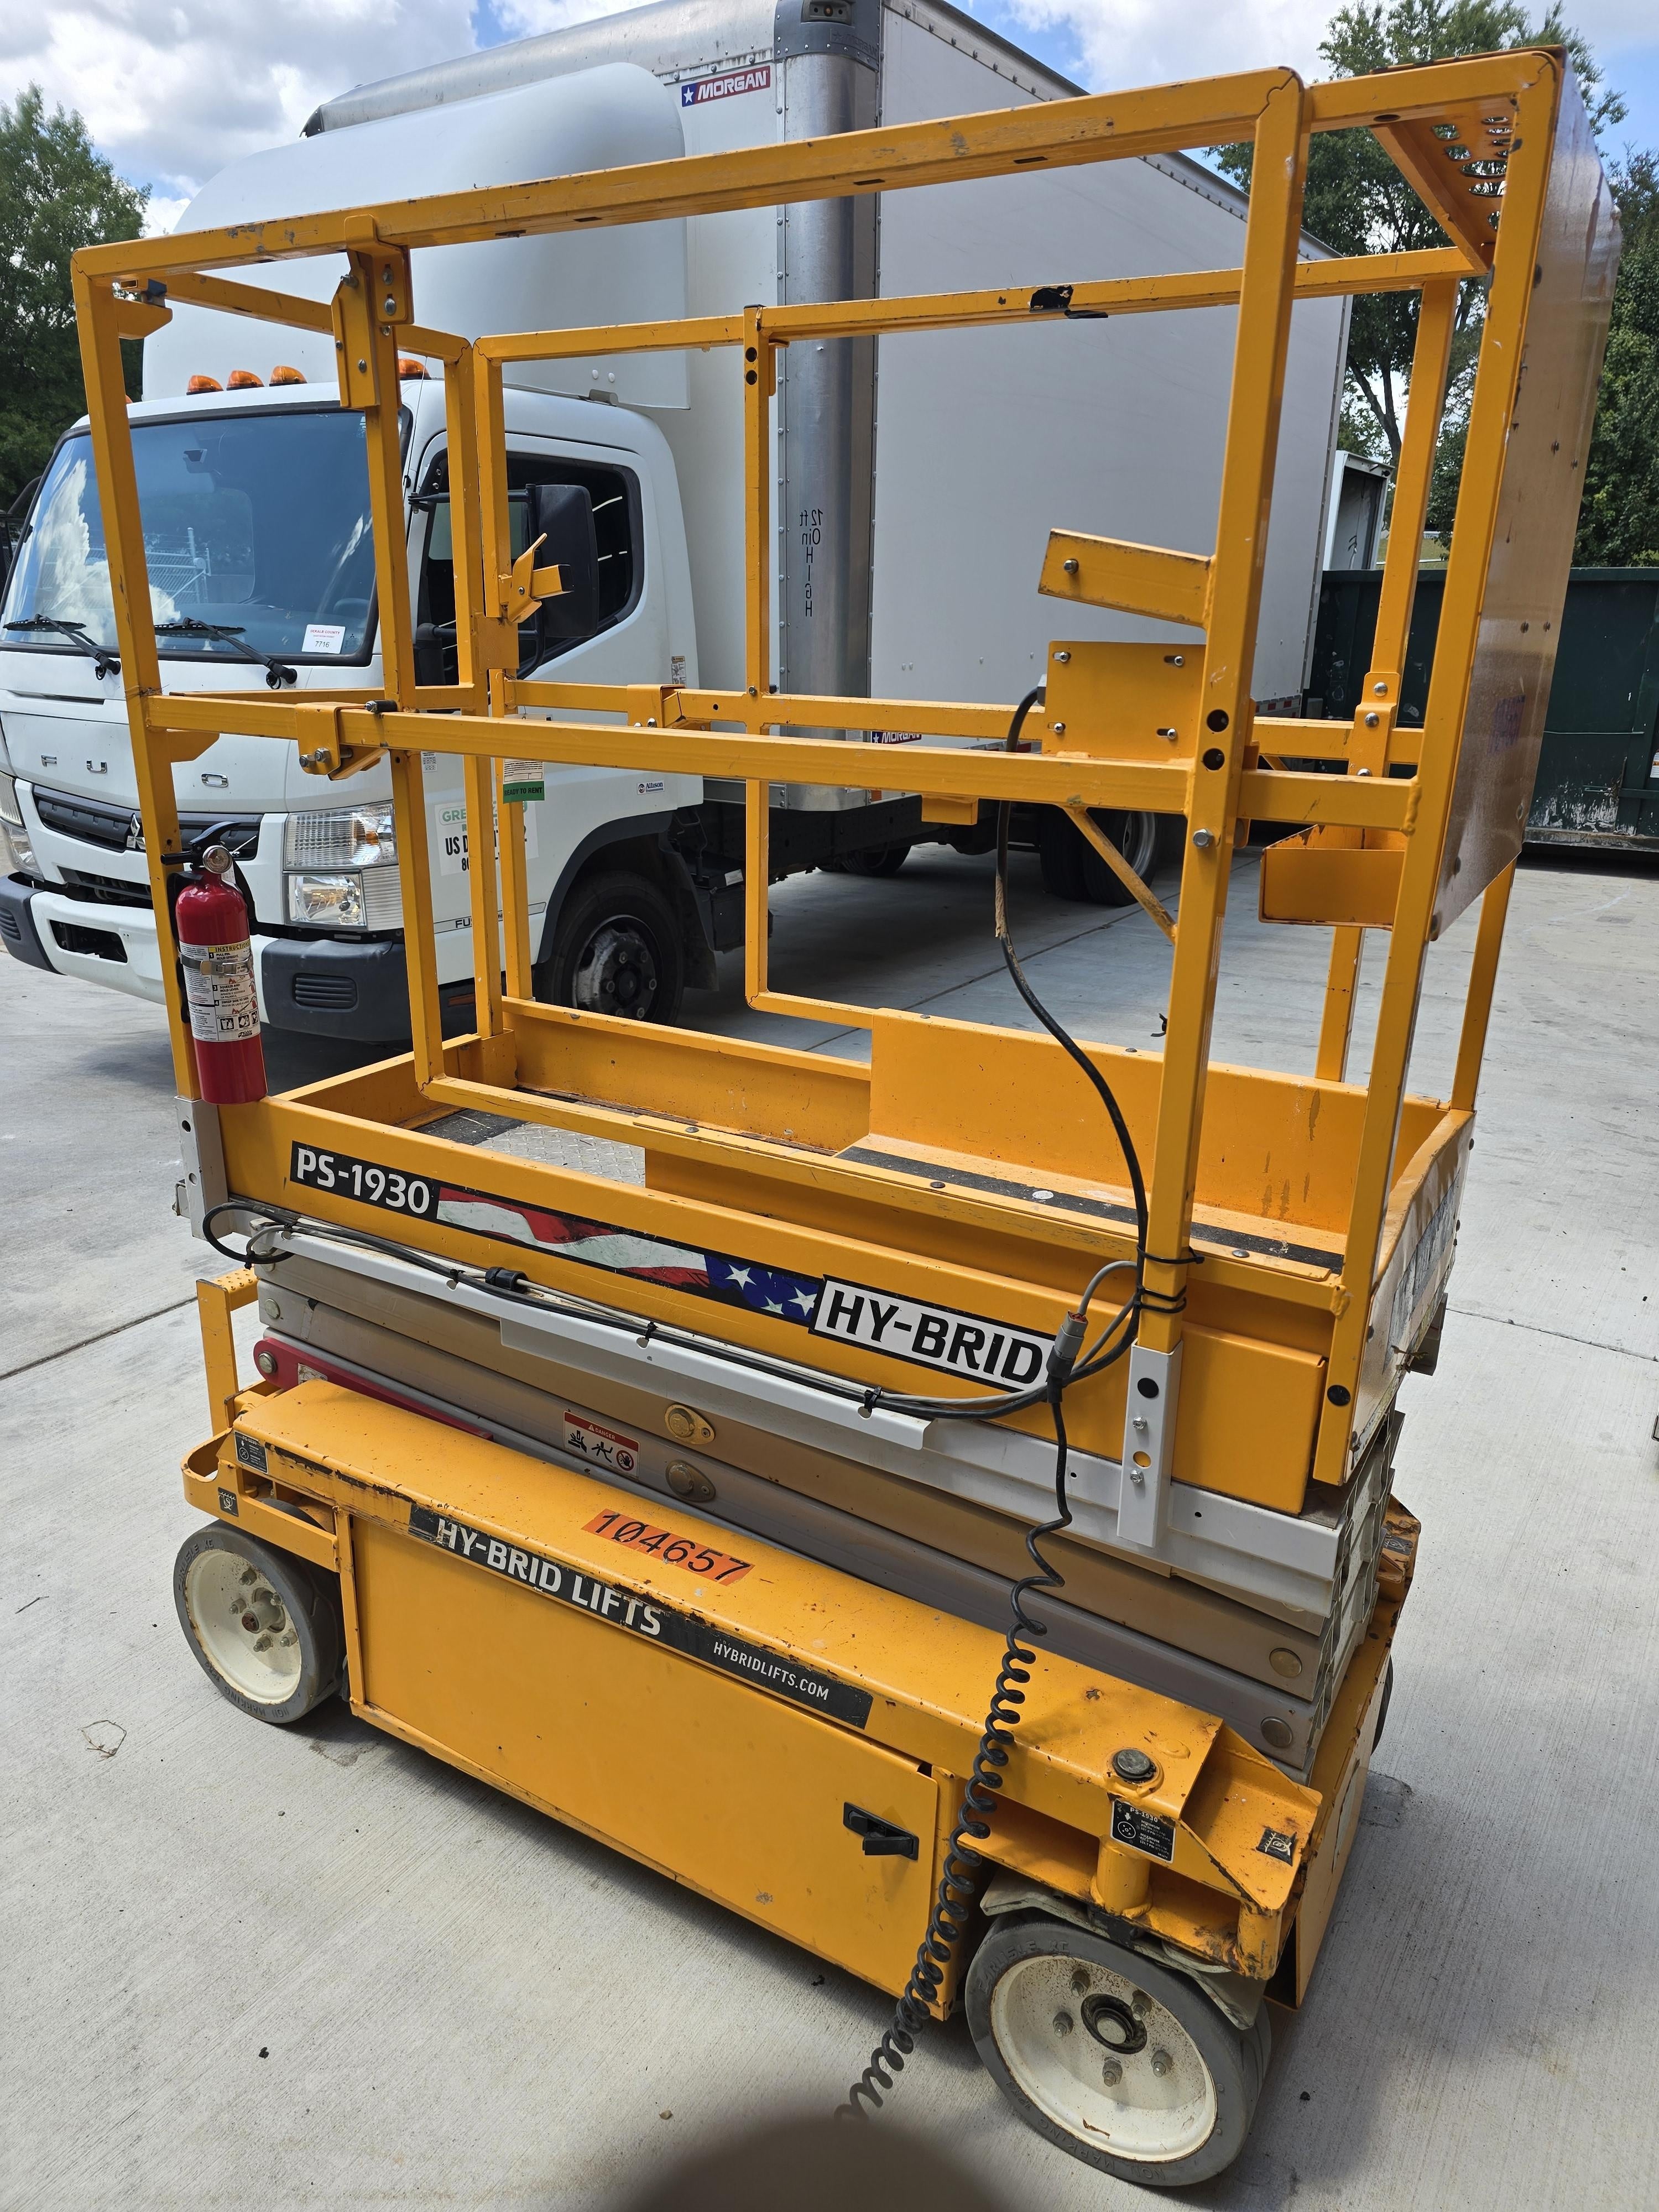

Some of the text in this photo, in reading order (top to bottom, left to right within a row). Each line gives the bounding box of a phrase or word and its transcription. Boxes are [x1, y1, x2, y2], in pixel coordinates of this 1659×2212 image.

[697, 70, 766, 101] MORGAN
[504, 788, 519, 796] READY
[445, 836, 461, 856] US
[215, 941, 250, 952] INSTRUCTIONS
[296, 1147, 430, 1214] PS-1930
[826, 1289, 1043, 1384] HY-BRID
[595, 1428, 615, 1440] DANGER
[595, 1513, 751, 1580] 104657
[437, 1519, 662, 1636] HY-BRID LIFTS
[713, 1641, 829, 1700] HYBRIDLIFTS.COM
[1130, 1807, 1158, 1823] PS-1930
[1141, 1820, 1160, 1830] MINIMUM
[1140, 1833, 1160, 1843] MAXIMUM
[1038, 2117, 1115, 2171] MARKING
